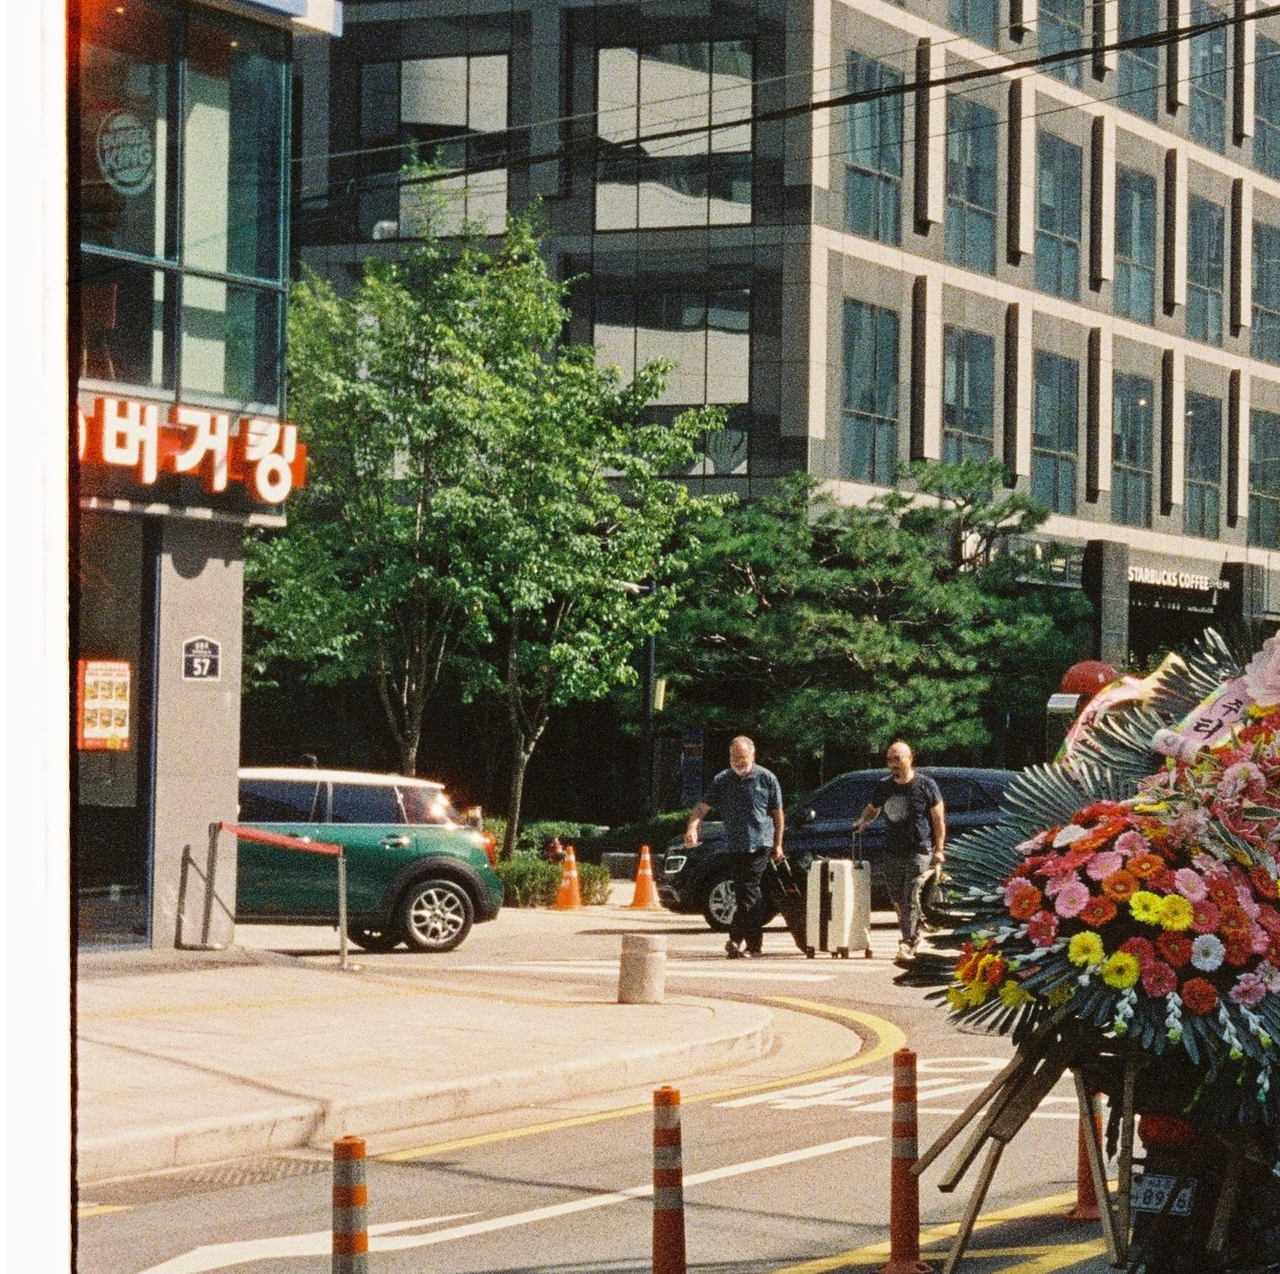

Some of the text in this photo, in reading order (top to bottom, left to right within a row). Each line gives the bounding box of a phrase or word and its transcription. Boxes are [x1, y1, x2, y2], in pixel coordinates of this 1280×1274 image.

[105, 144, 152, 170] KING
[102, 398, 297, 504] 버거킹
[1128, 566, 1178, 588] STARBUCKS
[1179, 572, 1210, 591] COFFEE
[193, 658, 211, 676] 57
